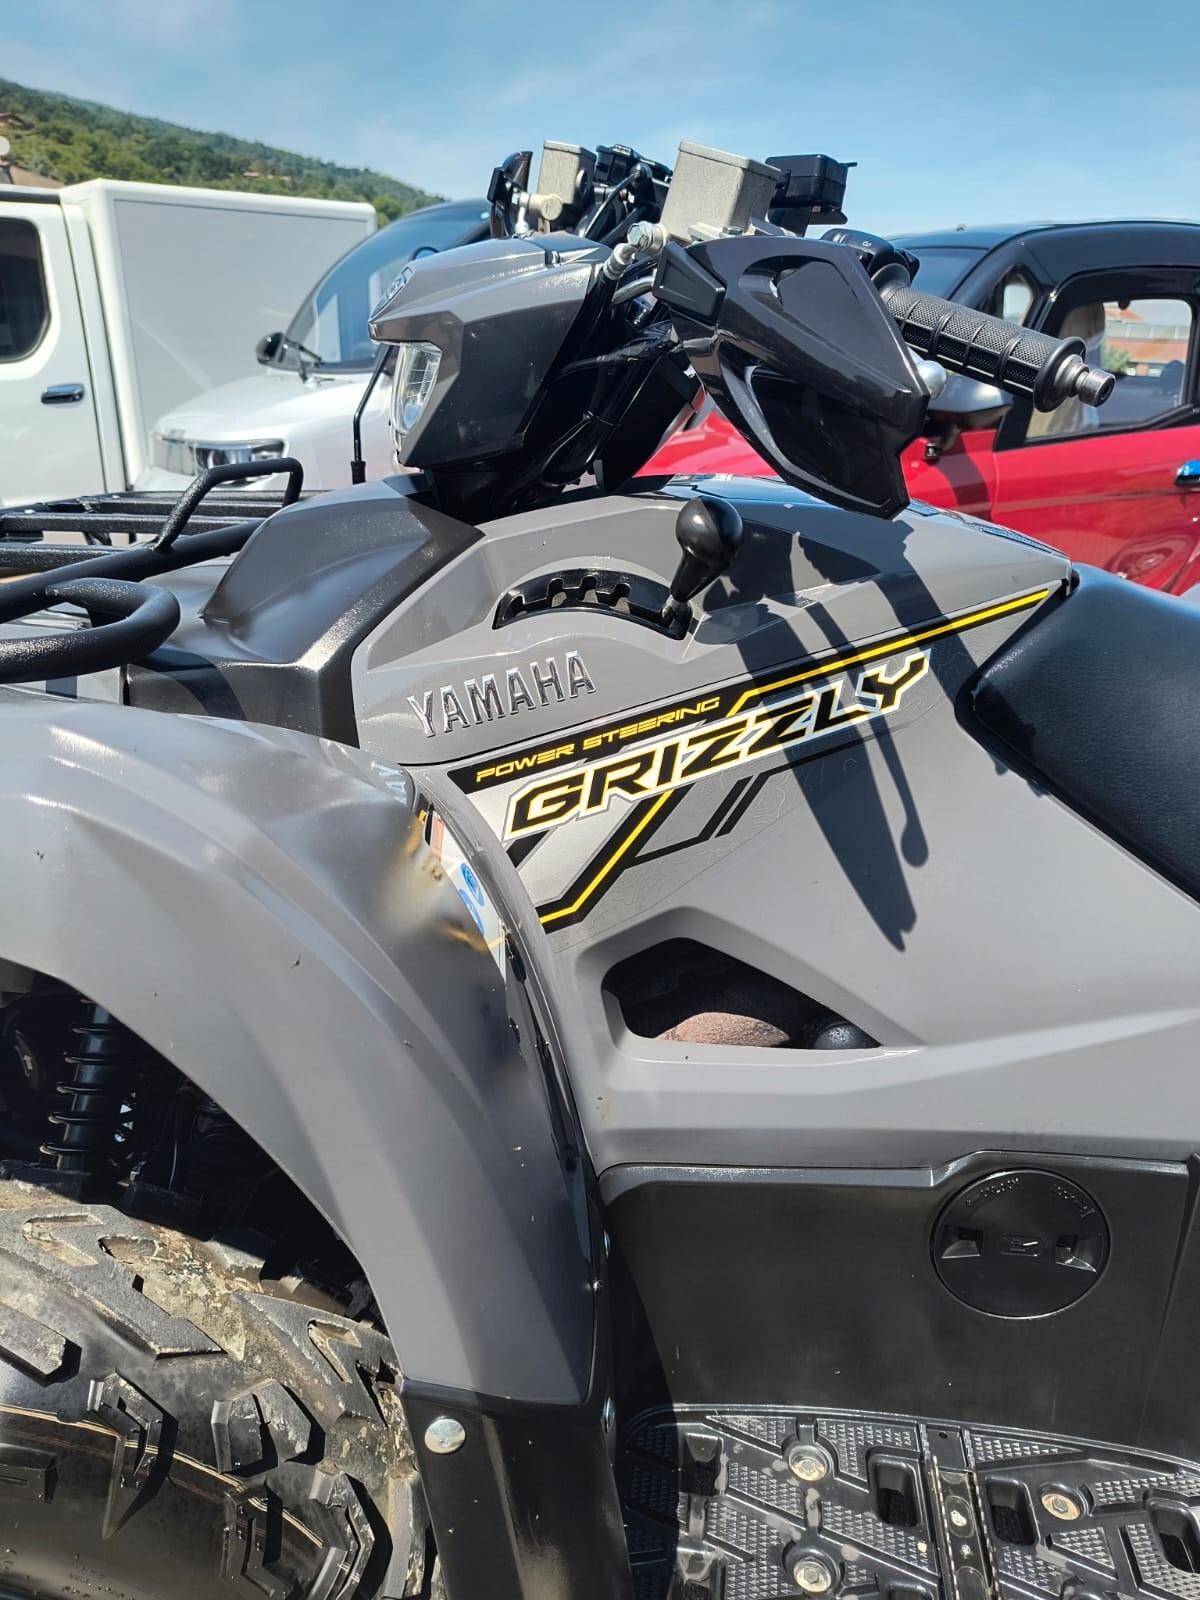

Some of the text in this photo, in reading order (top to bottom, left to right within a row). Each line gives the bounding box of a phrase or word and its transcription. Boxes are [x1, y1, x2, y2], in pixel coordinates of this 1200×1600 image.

[407, 650, 598, 738] YAMAHA
[476, 697, 721, 783] POWER STEERING
[506, 651, 930, 837] GRIZZLY
